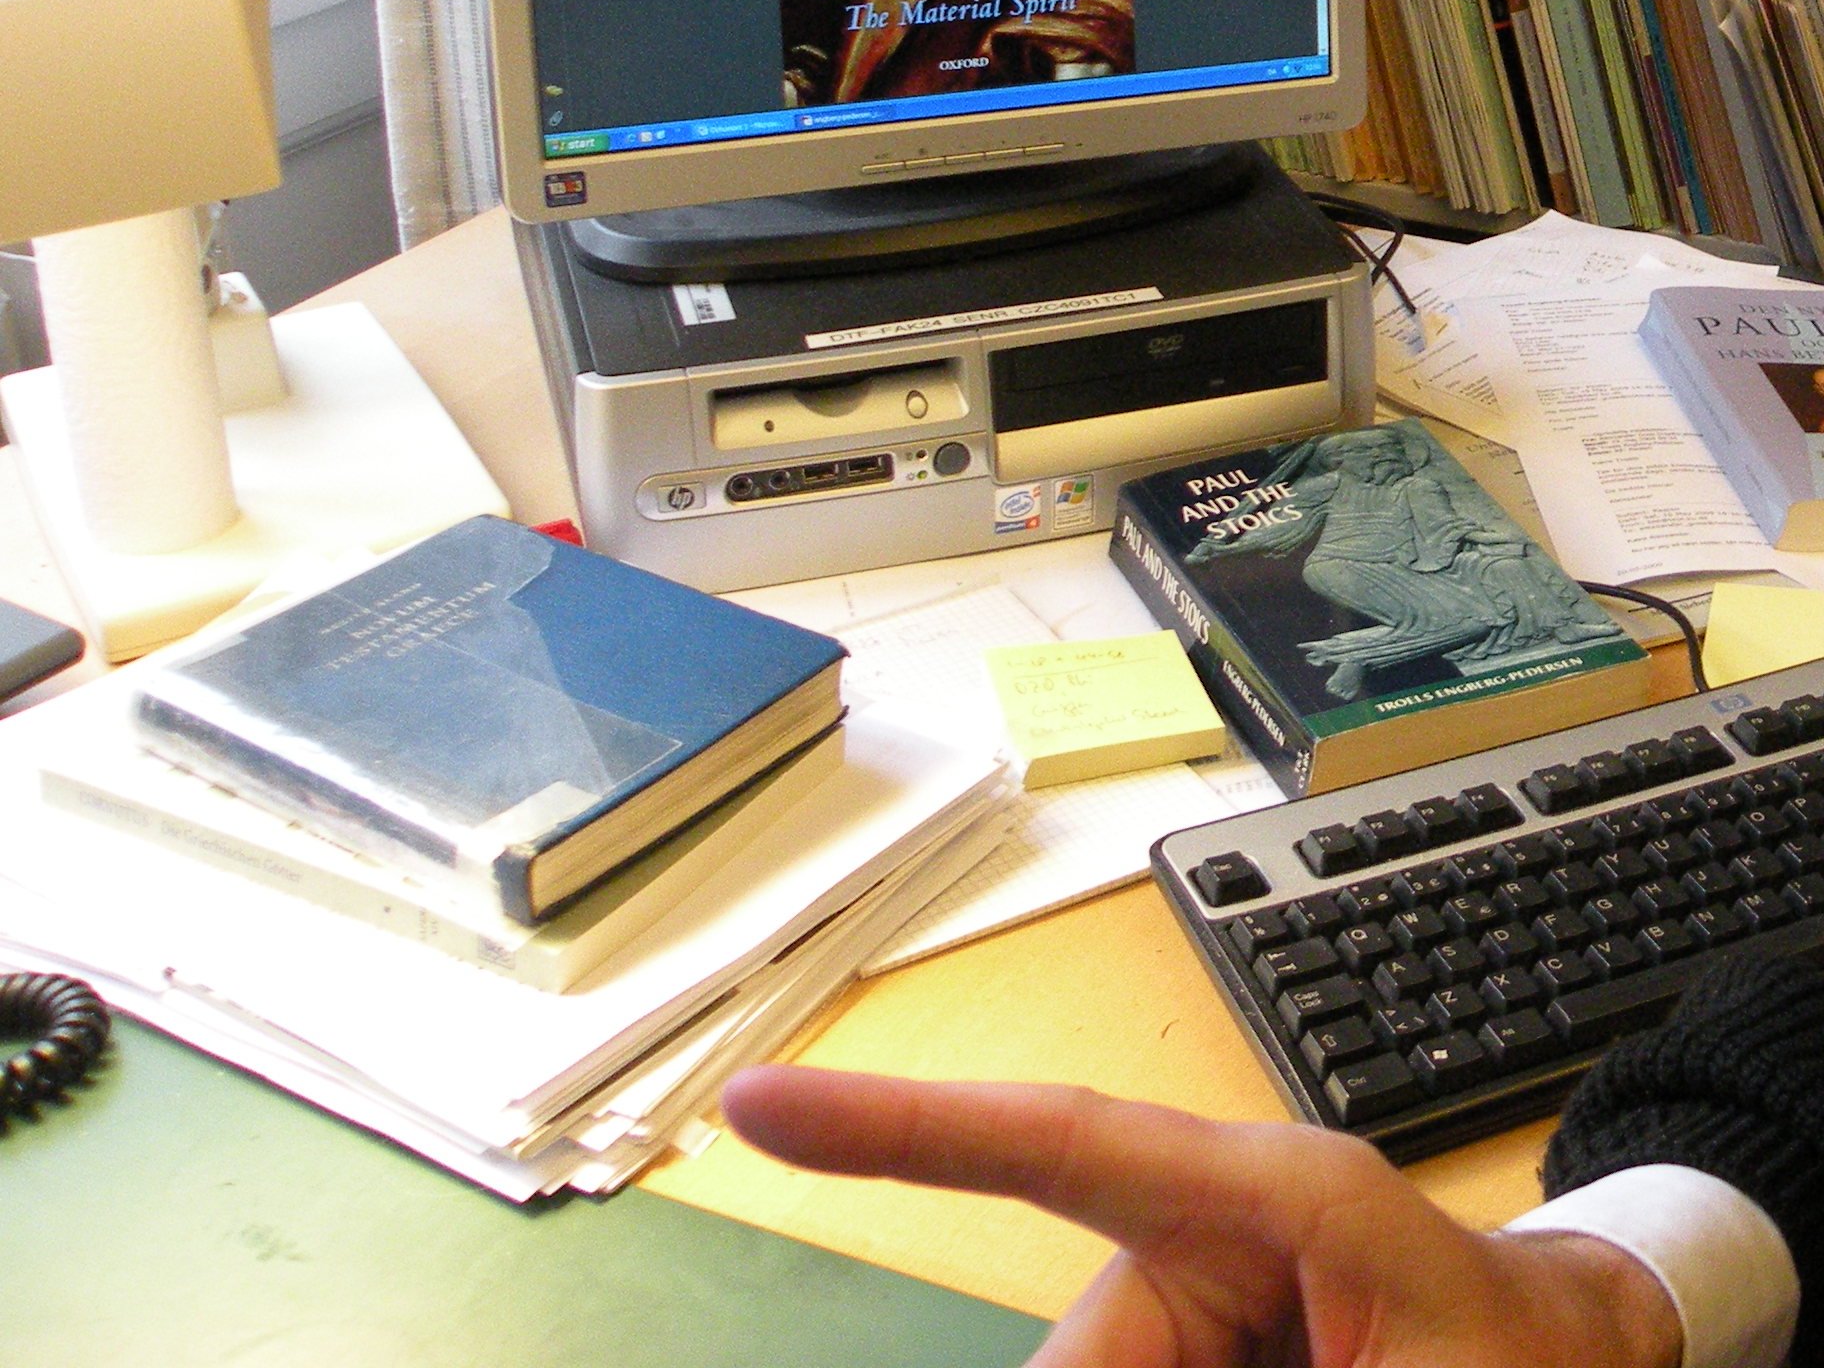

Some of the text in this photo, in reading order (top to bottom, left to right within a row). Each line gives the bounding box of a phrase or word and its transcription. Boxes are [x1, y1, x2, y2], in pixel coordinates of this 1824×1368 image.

[846, 3, 888, 31] The
[939, 57, 989, 71] OXFORD
[568, 137, 595, 150] start
[1739, 303, 1789, 314] DEN
[1719, 348, 1785, 359] HANS
[1186, 468, 1259, 496] PAUL
[1181, 480, 1298, 524] AND THE
[1206, 503, 1303, 541] STOICS
[322, 581, 497, 670] TESTAMENTUM
[351, 596, 437, 639] NOVUM
[1121, 515, 1286, 747] PAUL AND THE STOICS ENGBERG-PEDERSEN
[1374, 655, 1583, 714] TROELS ENGBERG-PEDERSEN
